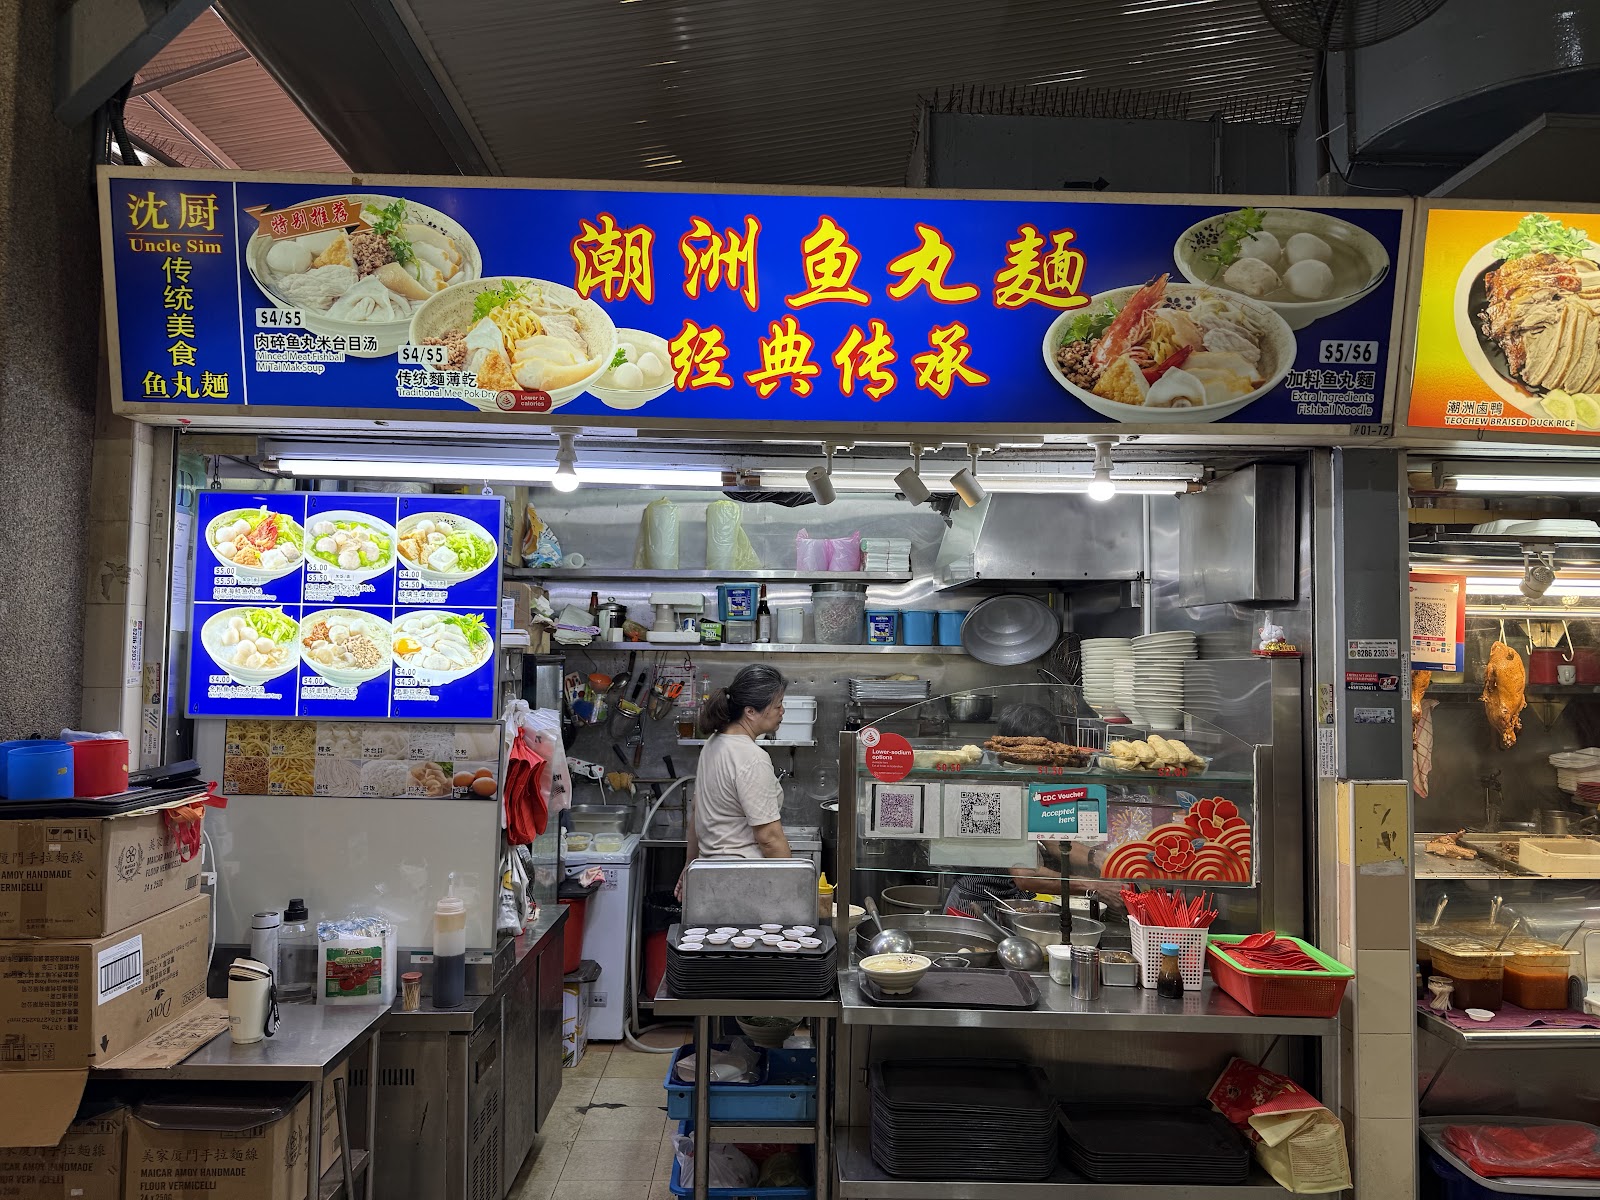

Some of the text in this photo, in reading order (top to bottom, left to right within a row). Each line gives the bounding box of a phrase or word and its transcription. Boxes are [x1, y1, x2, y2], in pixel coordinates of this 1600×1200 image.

[128, 191, 219, 231] 沈厨
[271, 201, 349, 235] 特别推荐
[130, 237, 222, 254] Uncle Sim
[161, 255, 199, 367] 传统美食
[261, 310, 301, 326] $4/$5
[255, 334, 378, 351] 肉碎鱼丸米台目汤
[257, 351, 344, 362] Minced Meat Fishball
[402, 347, 443, 363] $4/$5
[668, 314, 991, 402] 经典传承
[1324, 343, 1372, 362] $5/$6
[257, 362, 324, 373] Mi Tai Mak Soup
[398, 388, 497, 400] Traditional Mee Pok Dry
[1292, 391, 1374, 404] Extra Ingredients
[1297, 404, 1373, 416] Fishball Noodle
[1445, 416, 1575, 427] TEOCHEW BRAISED DUCK RICE
[1353, 425, 1389, 436] #01-72
[311, 498, 316, 508] 2
[404, 500, 409, 509] 3
[872, 748, 912, 756] Lower-sodium
[1042, 791, 1084, 802] CDC Voucher
[1041, 807, 1075, 818] Accepted
[1058, 816, 1075, 824] here
[1, 869, 72, 880] AMOY HANDMADE
[0, 883, 43, 892] ERMICELLI
[146, 997, 172, 1023] Dove
[0, 1163, 21, 1171] ICAR
[22, 1162, 44, 1171] AMOY
[140, 1167, 247, 1178] MAICAR AMOY HANDMADE
[140, 1180, 217, 1191] FLOUR VERMICELLI
